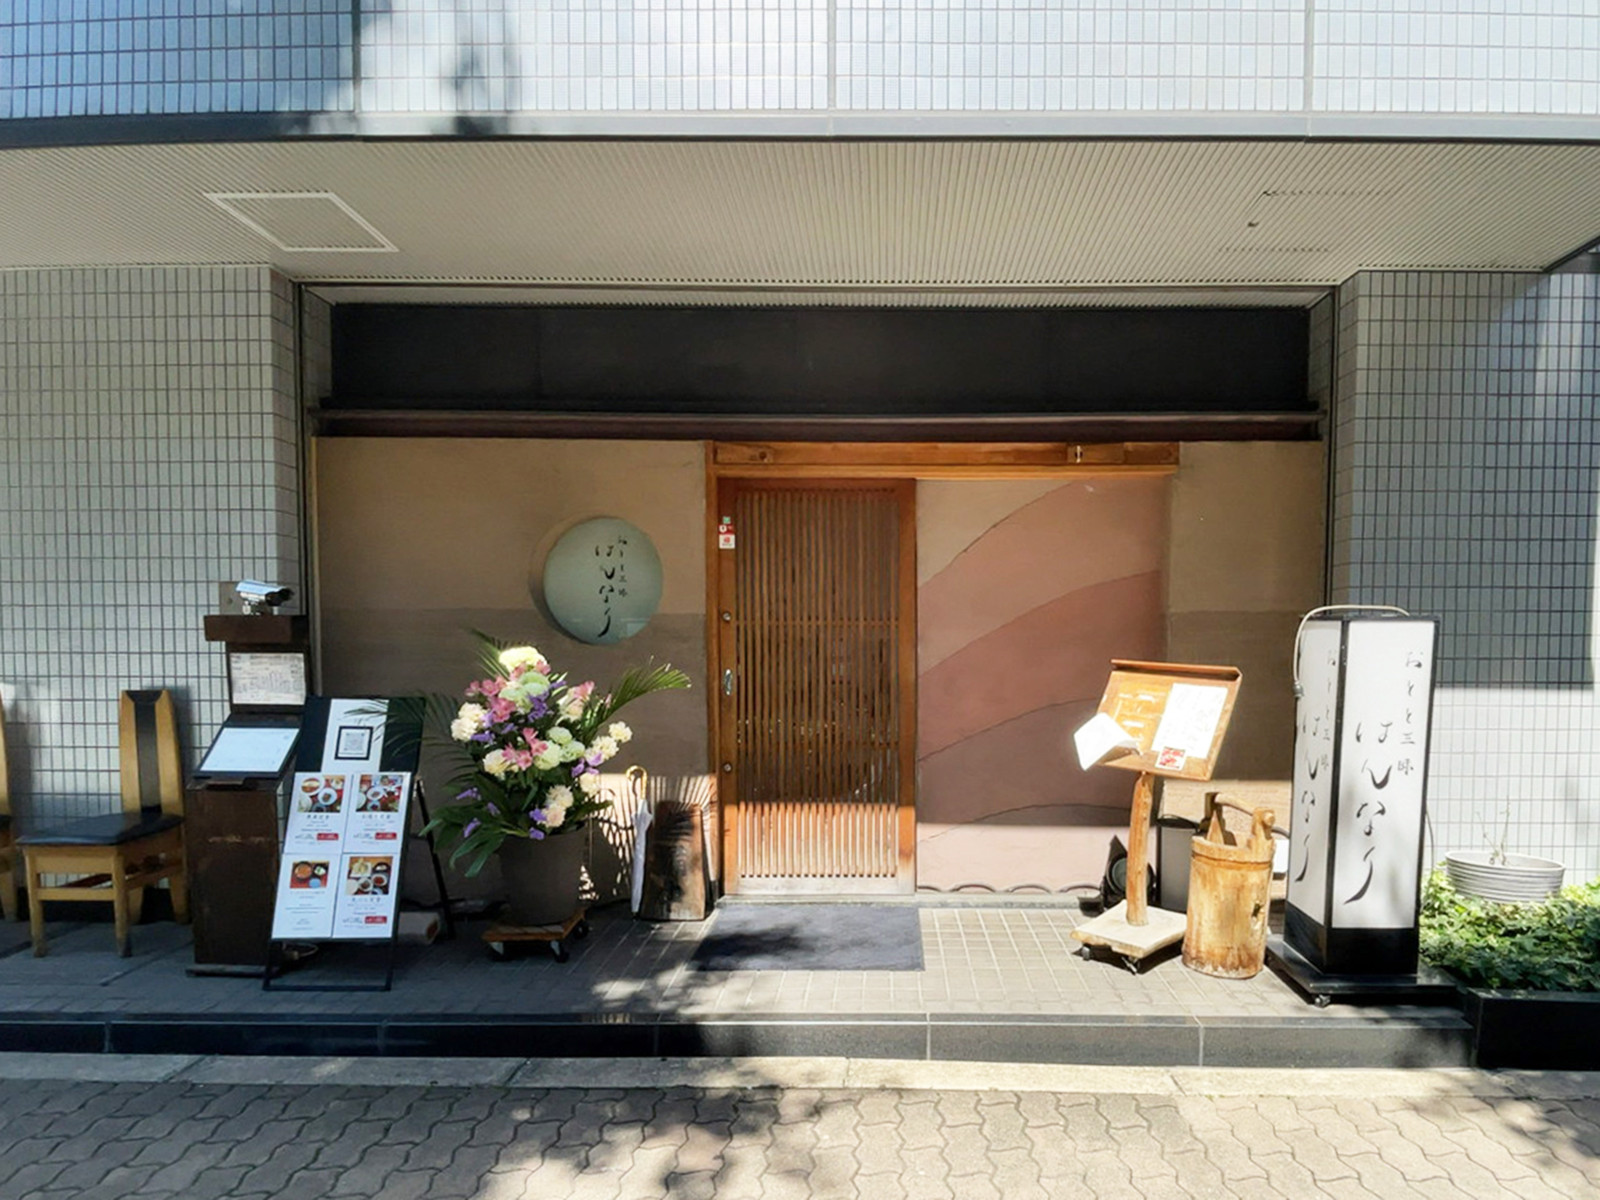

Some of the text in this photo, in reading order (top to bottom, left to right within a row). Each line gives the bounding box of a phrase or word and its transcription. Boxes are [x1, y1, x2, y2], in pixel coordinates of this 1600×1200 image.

[594, 545, 615, 638] はんなり
[1294, 712, 1320, 882] はんなり
[1343, 721, 1393, 905] はんなり
